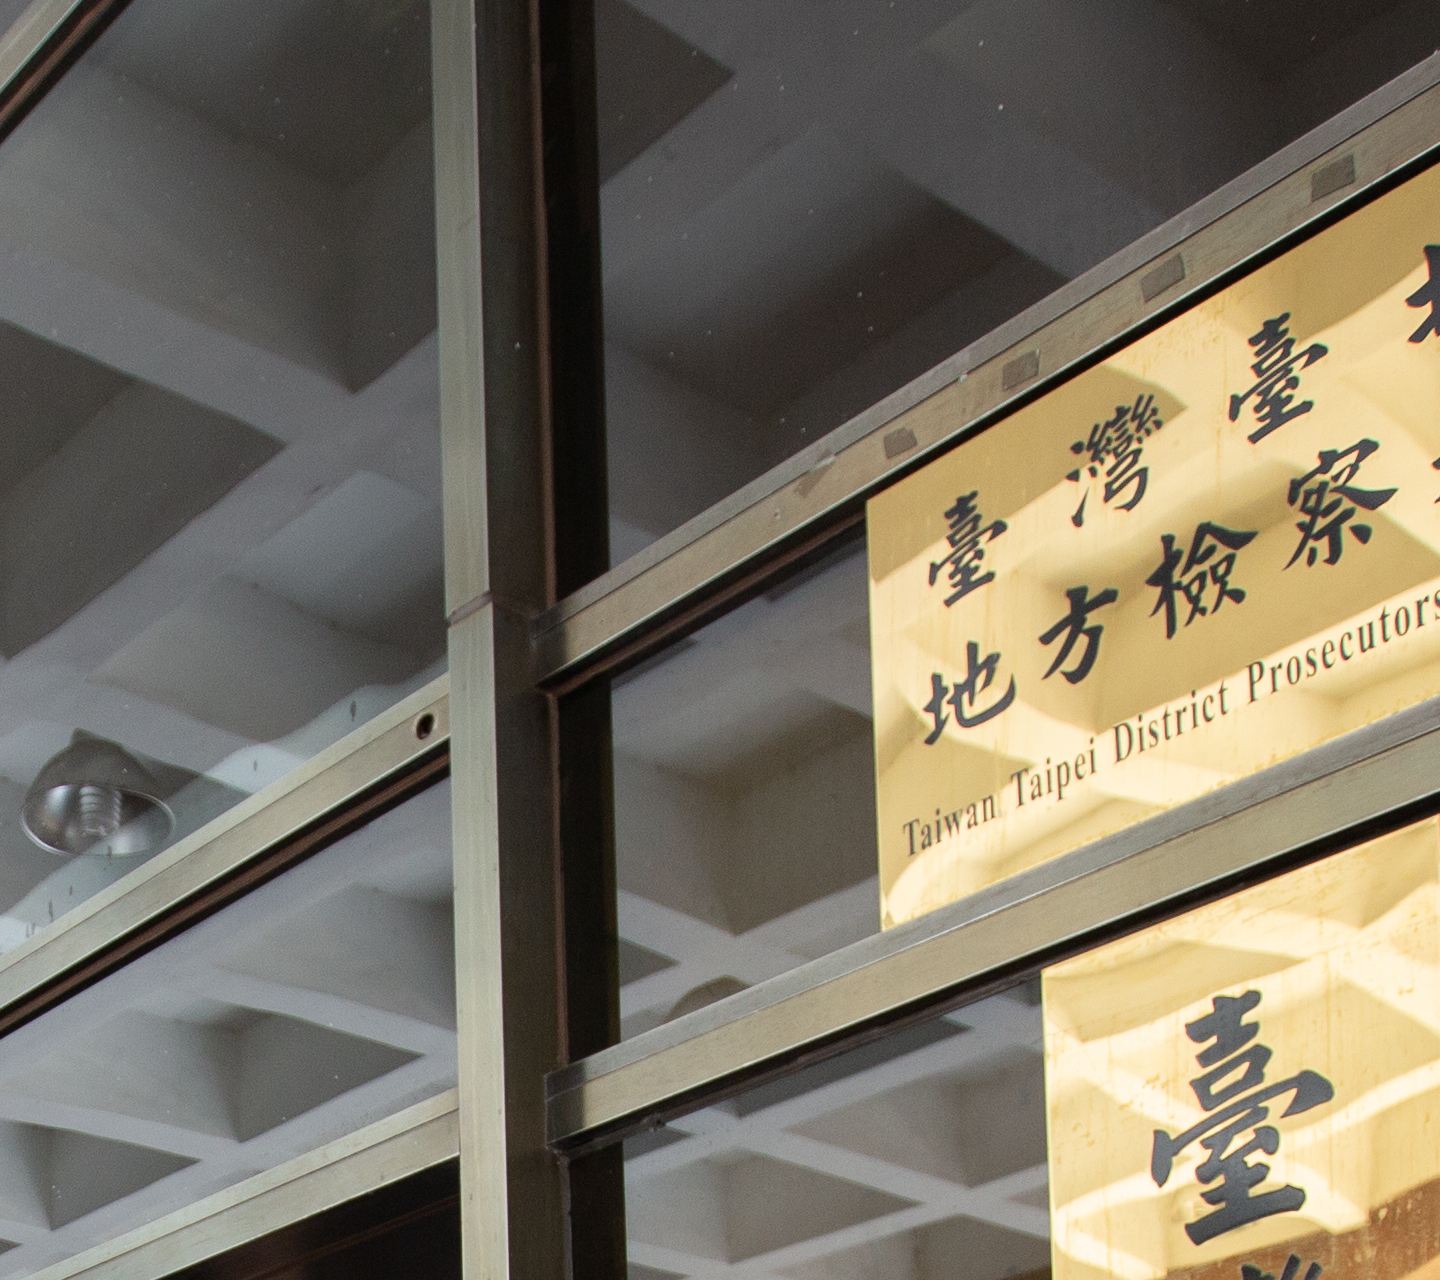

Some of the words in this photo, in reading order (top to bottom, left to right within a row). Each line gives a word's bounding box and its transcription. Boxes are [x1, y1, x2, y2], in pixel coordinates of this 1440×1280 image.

[903, 792, 997, 857] Taiwan
[1011, 737, 1098, 808] Taipei
[1114, 681, 1229, 764] District
